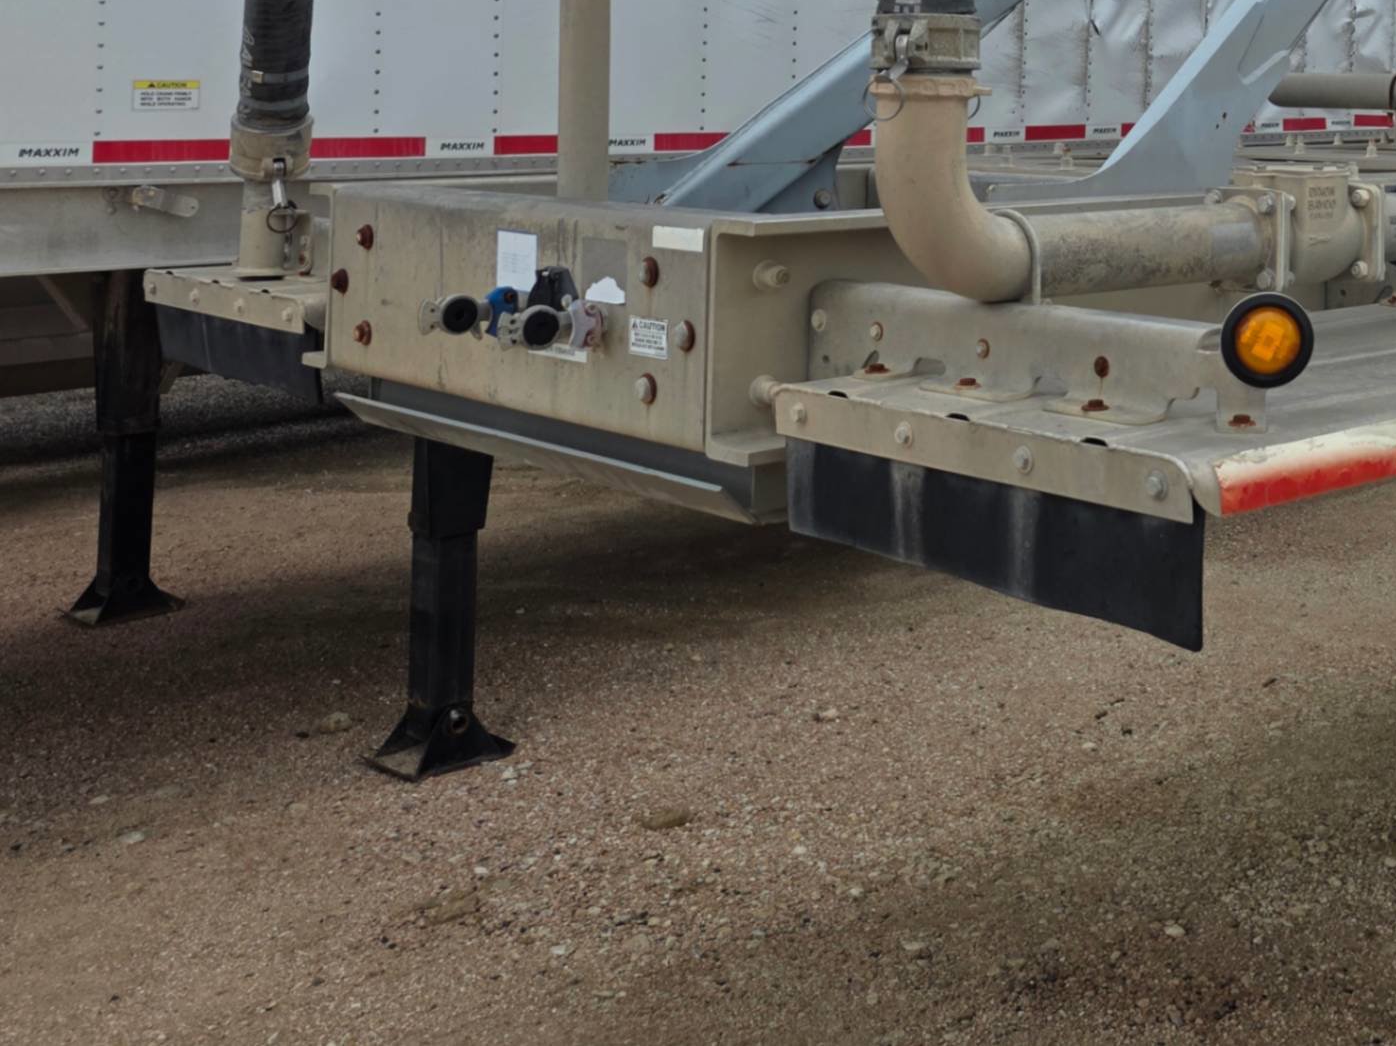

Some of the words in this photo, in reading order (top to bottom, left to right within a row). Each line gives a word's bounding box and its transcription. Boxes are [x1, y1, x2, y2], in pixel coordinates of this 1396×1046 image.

[440, 141, 485, 151] MAXXIM
[608, 138, 646, 147] MAXXIM
[18, 147, 80, 158] MAXXIM
[639, 320, 665, 331] CAUTION
